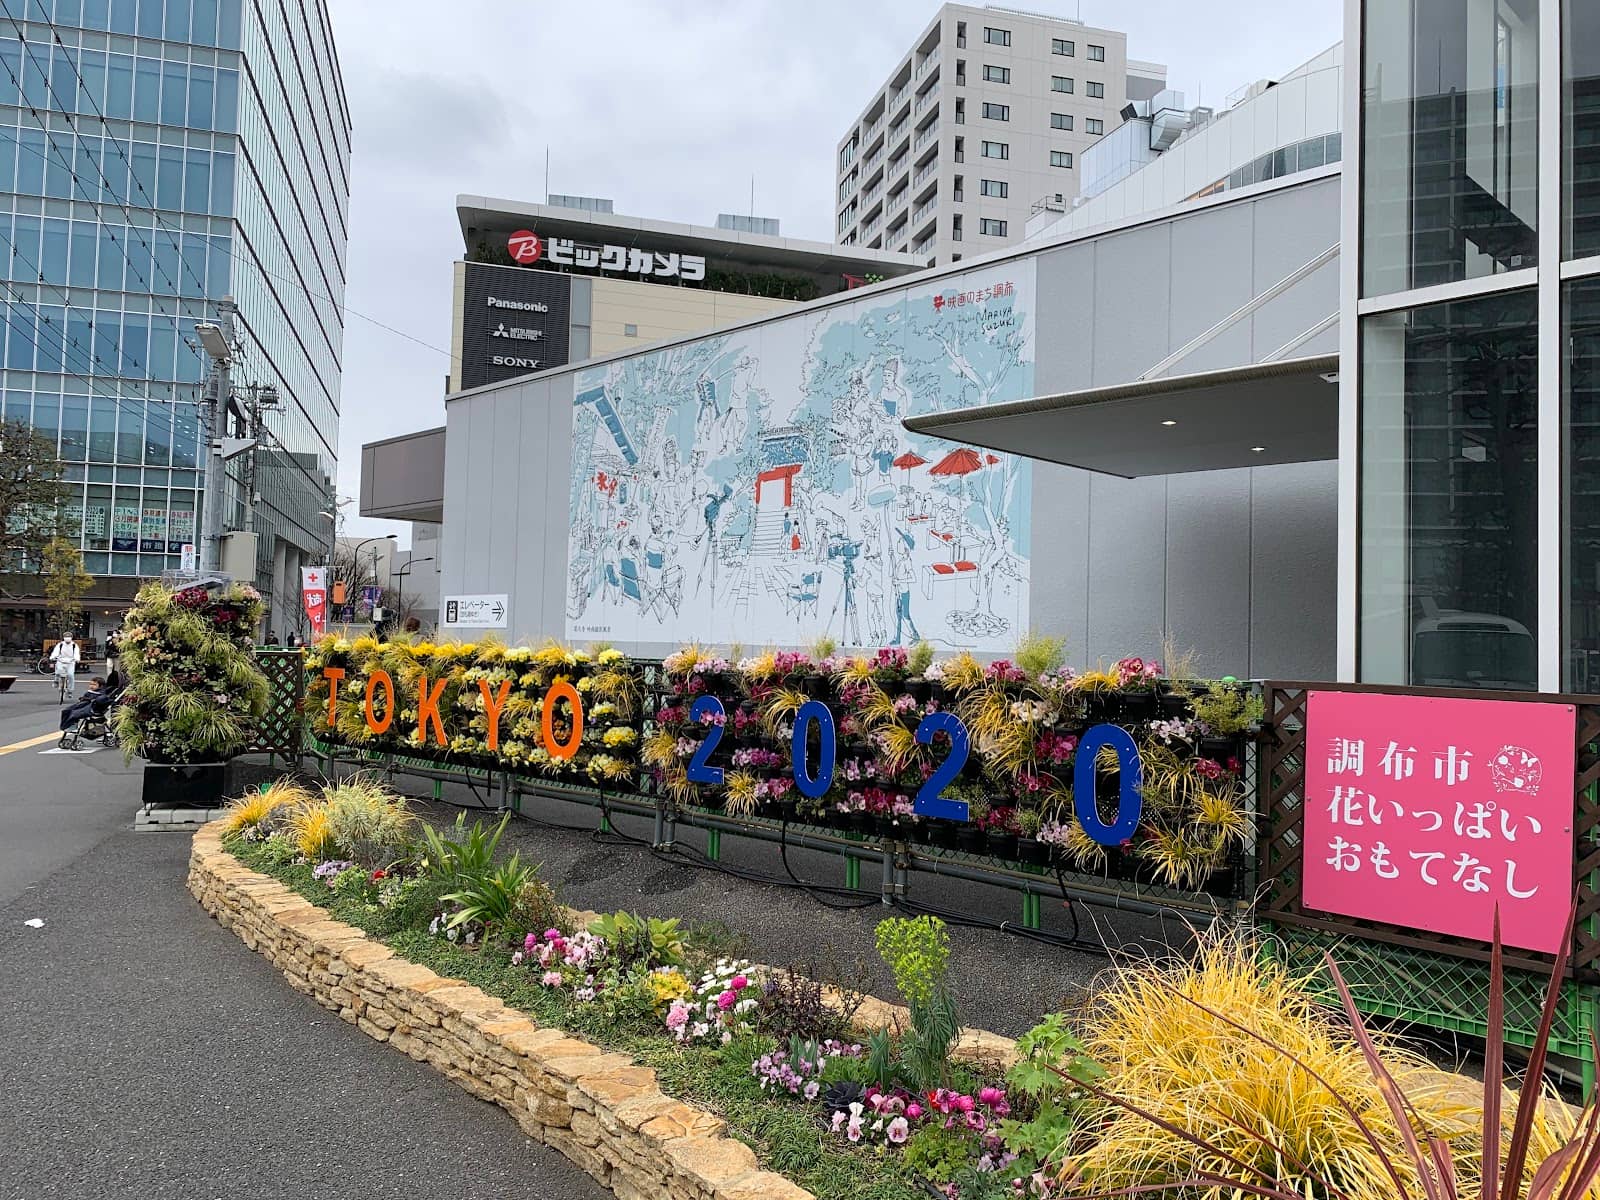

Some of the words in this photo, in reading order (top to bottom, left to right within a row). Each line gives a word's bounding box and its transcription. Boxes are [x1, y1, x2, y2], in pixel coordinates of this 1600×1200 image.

[547, 237, 706, 281] ビックカメラ
[487, 296, 549, 313] Panasonic
[946, 281, 1015, 310] 映画のまち調布
[492, 355, 540, 368] SONY
[459, 600, 490, 610] エレベーター
[323, 667, 584, 760] TOKYO
[687, 695, 1143, 846] 2020
[1327, 737, 1474, 786] 調布市
[1326, 785, 1542, 842] 花いっぱい
[1326, 836, 1540, 899] おもてなし
